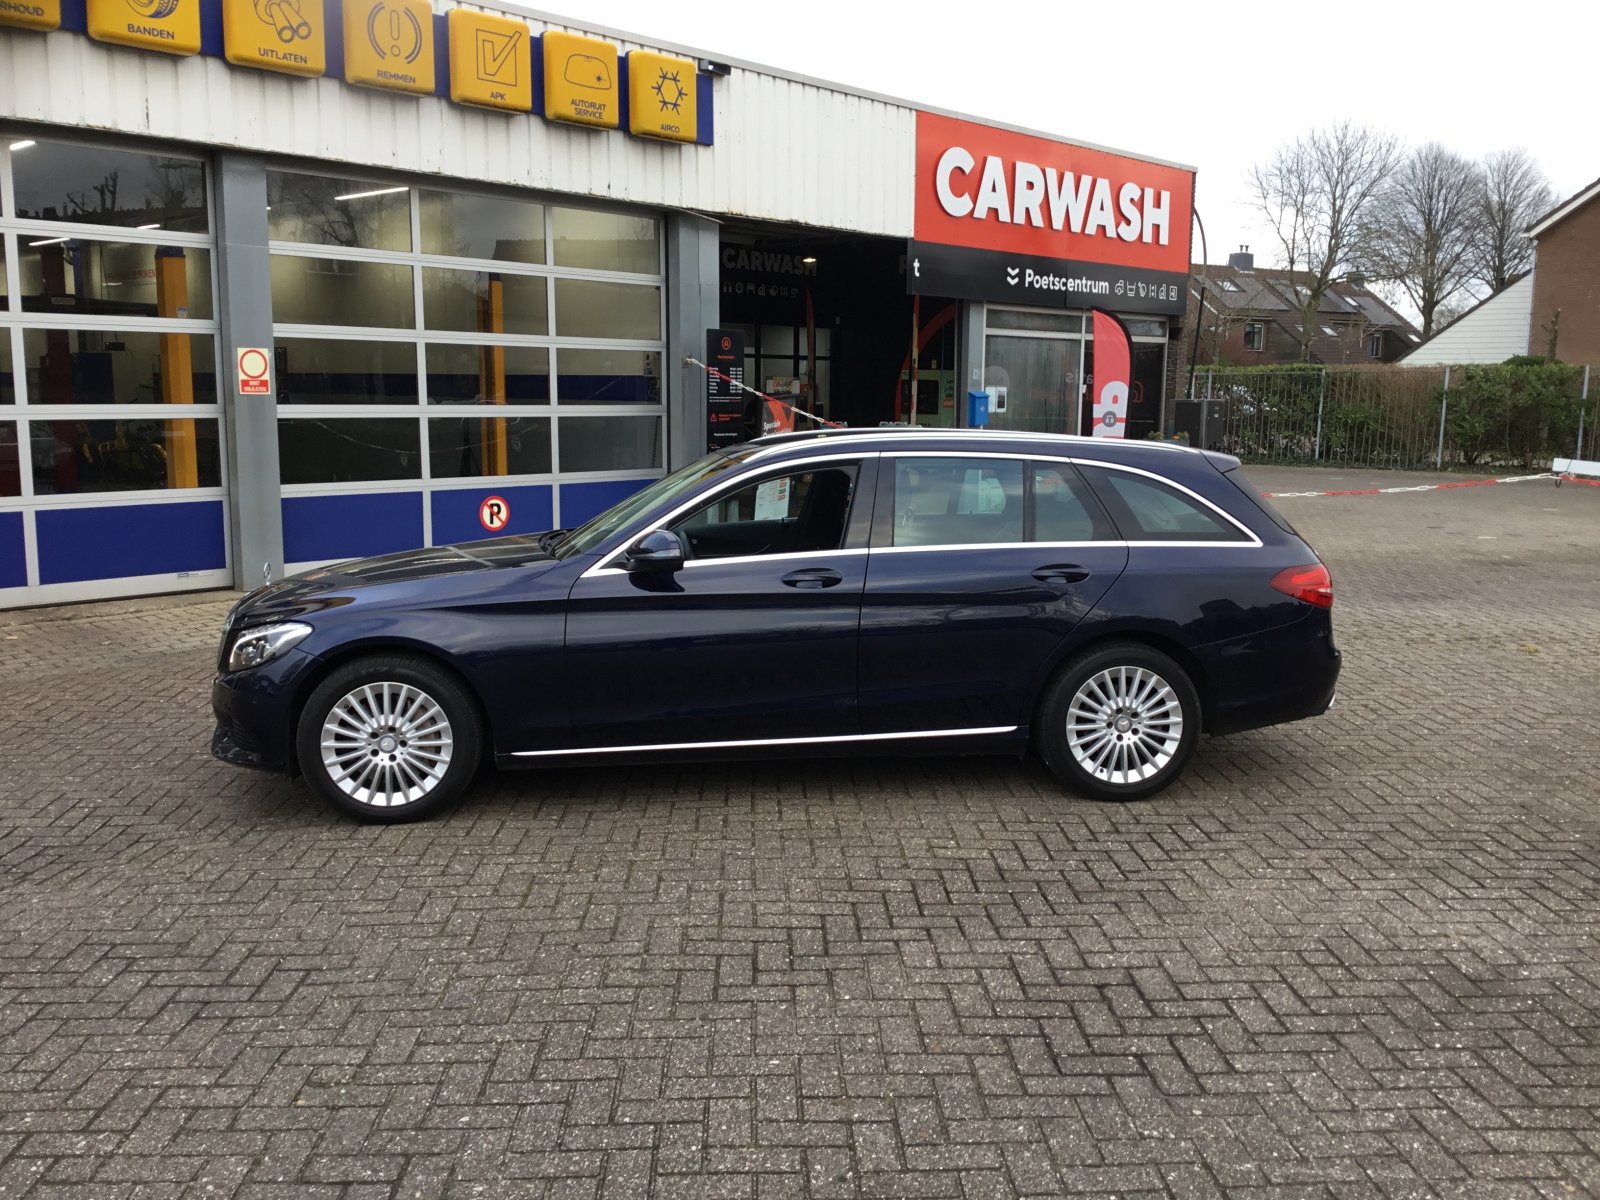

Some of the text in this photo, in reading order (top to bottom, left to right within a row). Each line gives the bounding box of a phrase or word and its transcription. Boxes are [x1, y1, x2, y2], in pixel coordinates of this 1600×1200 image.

[127, 23, 175, 41] BANDEN
[258, 47, 308, 65] UITLATEN
[376, 69, 416, 84] REMMEN
[490, 91, 506, 101] APK
[570, 98, 607, 112] AUTORUIT
[574, 107, 603, 120] SERVICE
[660, 123, 681, 134] AIRCO
[936, 146, 1171, 246] CARWASH
[722, 248, 817, 277] CARWASH
[1025, 268, 1109, 295] Poetscentrum
[489, 502, 502, 525] P
